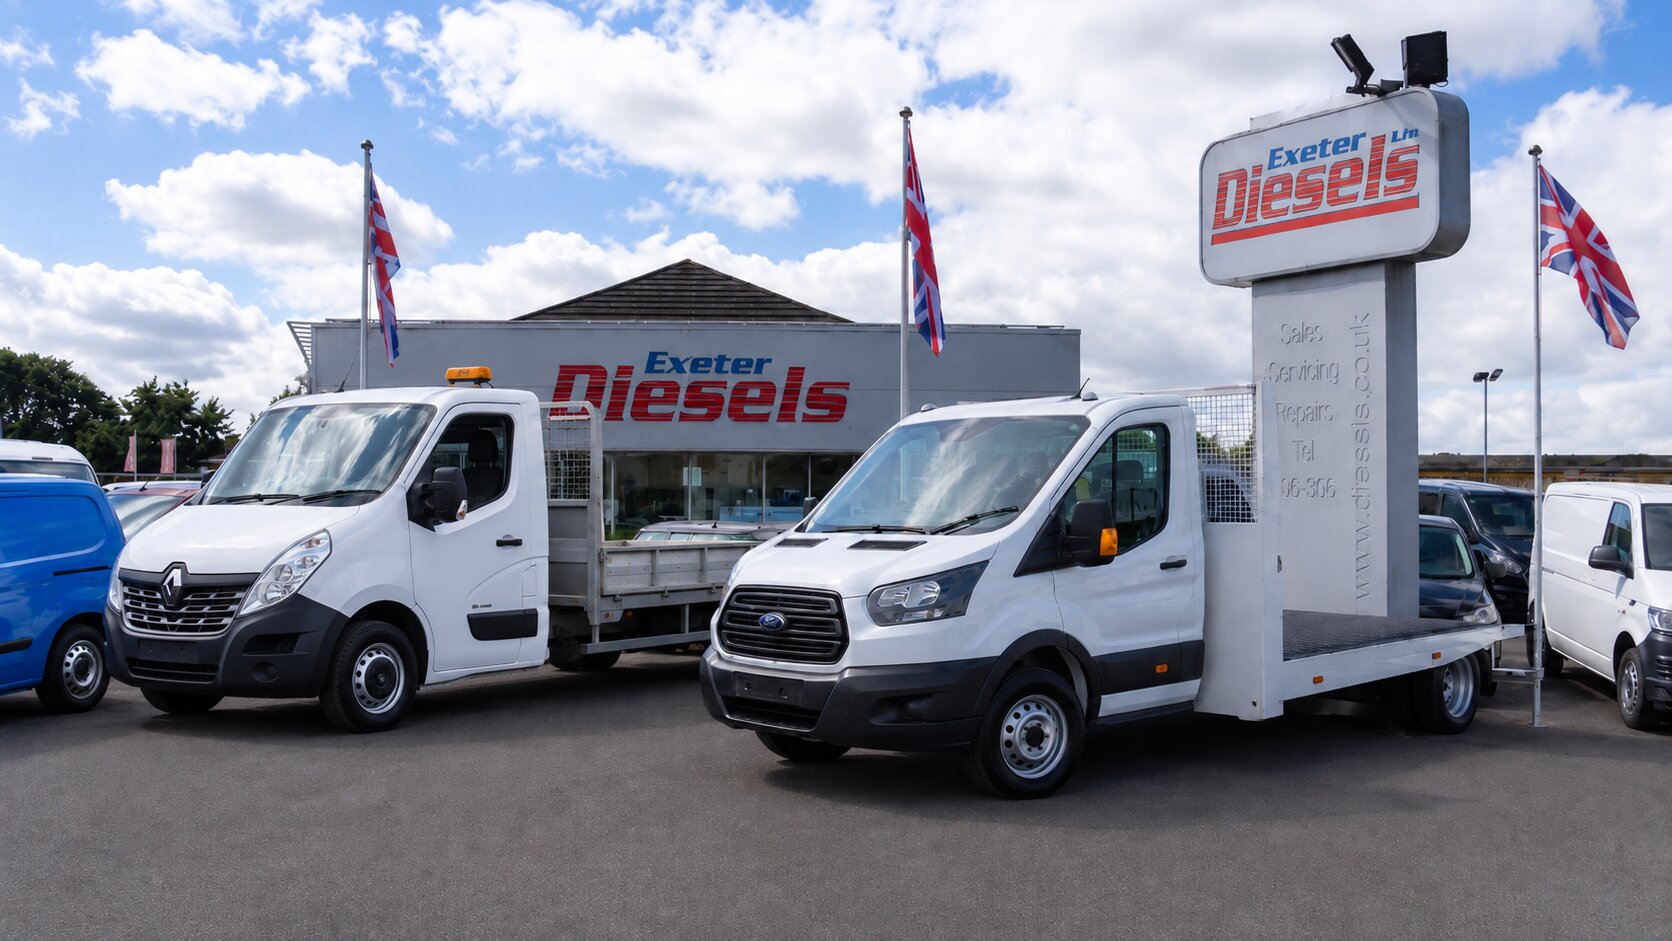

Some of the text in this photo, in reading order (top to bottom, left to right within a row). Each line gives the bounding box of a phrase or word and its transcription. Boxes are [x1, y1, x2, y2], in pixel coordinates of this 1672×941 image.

[1267, 132, 1367, 170] Exeter
[1212, 134, 1420, 230] Diesels
[1280, 321, 1324, 345] Sales
[644, 351, 772, 375] Exeter
[1268, 359, 1339, 385] Servicing
[548, 364, 850, 423] Diesels
[1276, 400, 1334, 428] Repairs
[1292, 439, 1315, 462] Tel
